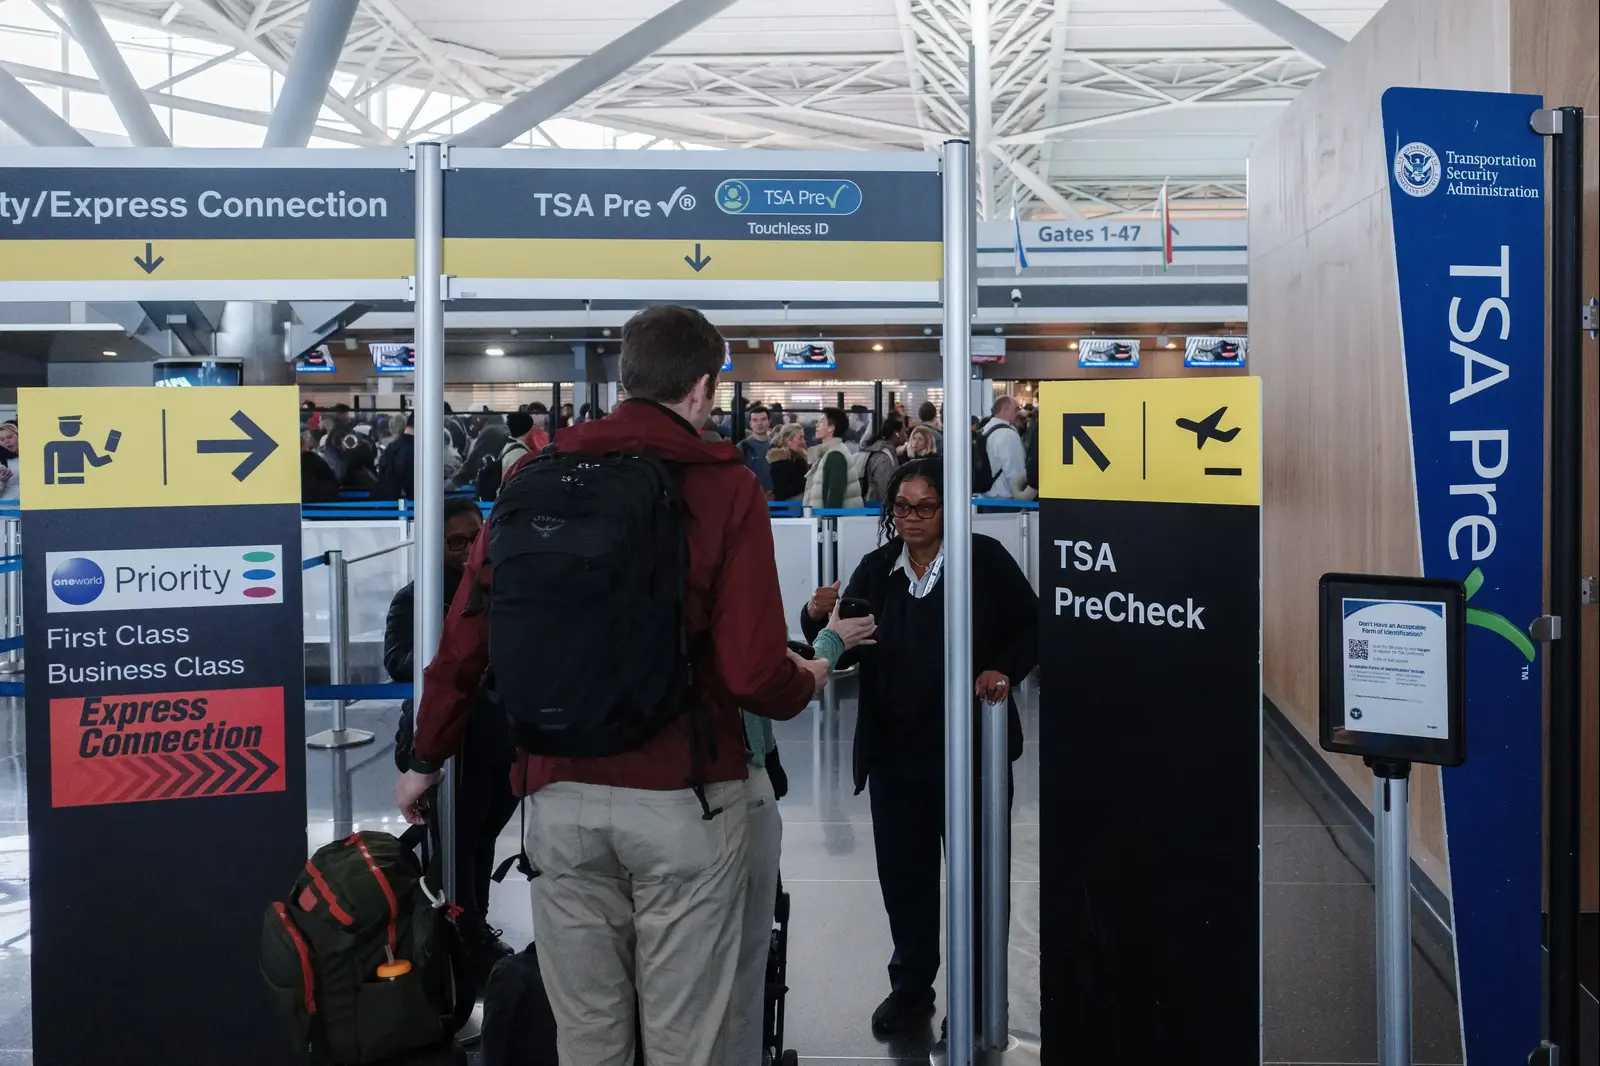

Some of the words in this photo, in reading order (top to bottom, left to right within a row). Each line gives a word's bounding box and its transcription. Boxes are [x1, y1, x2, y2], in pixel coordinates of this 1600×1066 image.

[1445, 150, 1537, 169] Transportation
[1446, 167, 1499, 185] Security
[763, 190, 795, 205] TSA
[1446, 182, 1539, 198] Administration
[198, 191, 387, 218] Connection
[533, 193, 594, 217] TSA
[747, 222, 812, 235] Touchless
[815, 223, 829, 235] ID
[1038, 226, 1094, 243] Gates
[1101, 226, 1141, 242] 1-47
[1448, 245, 1511, 405] TSA
[1054, 540, 1117, 573] TSA
[53, 576, 103, 586] oneworld
[116, 564, 231, 595] Priority
[1055, 587, 1206, 630] PreCheck
[47, 628, 107, 649] First
[116, 624, 190, 646] Class
[1383, 629, 1424, 637] Identification?
[1396, 623, 1427, 631] Acceptable
[48, 661, 167, 684] Business
[174, 656, 245, 678] Class
[1521, 664, 1529, 681] TM
[79, 696, 208, 731] Express
[79, 720, 263, 758] Connection
